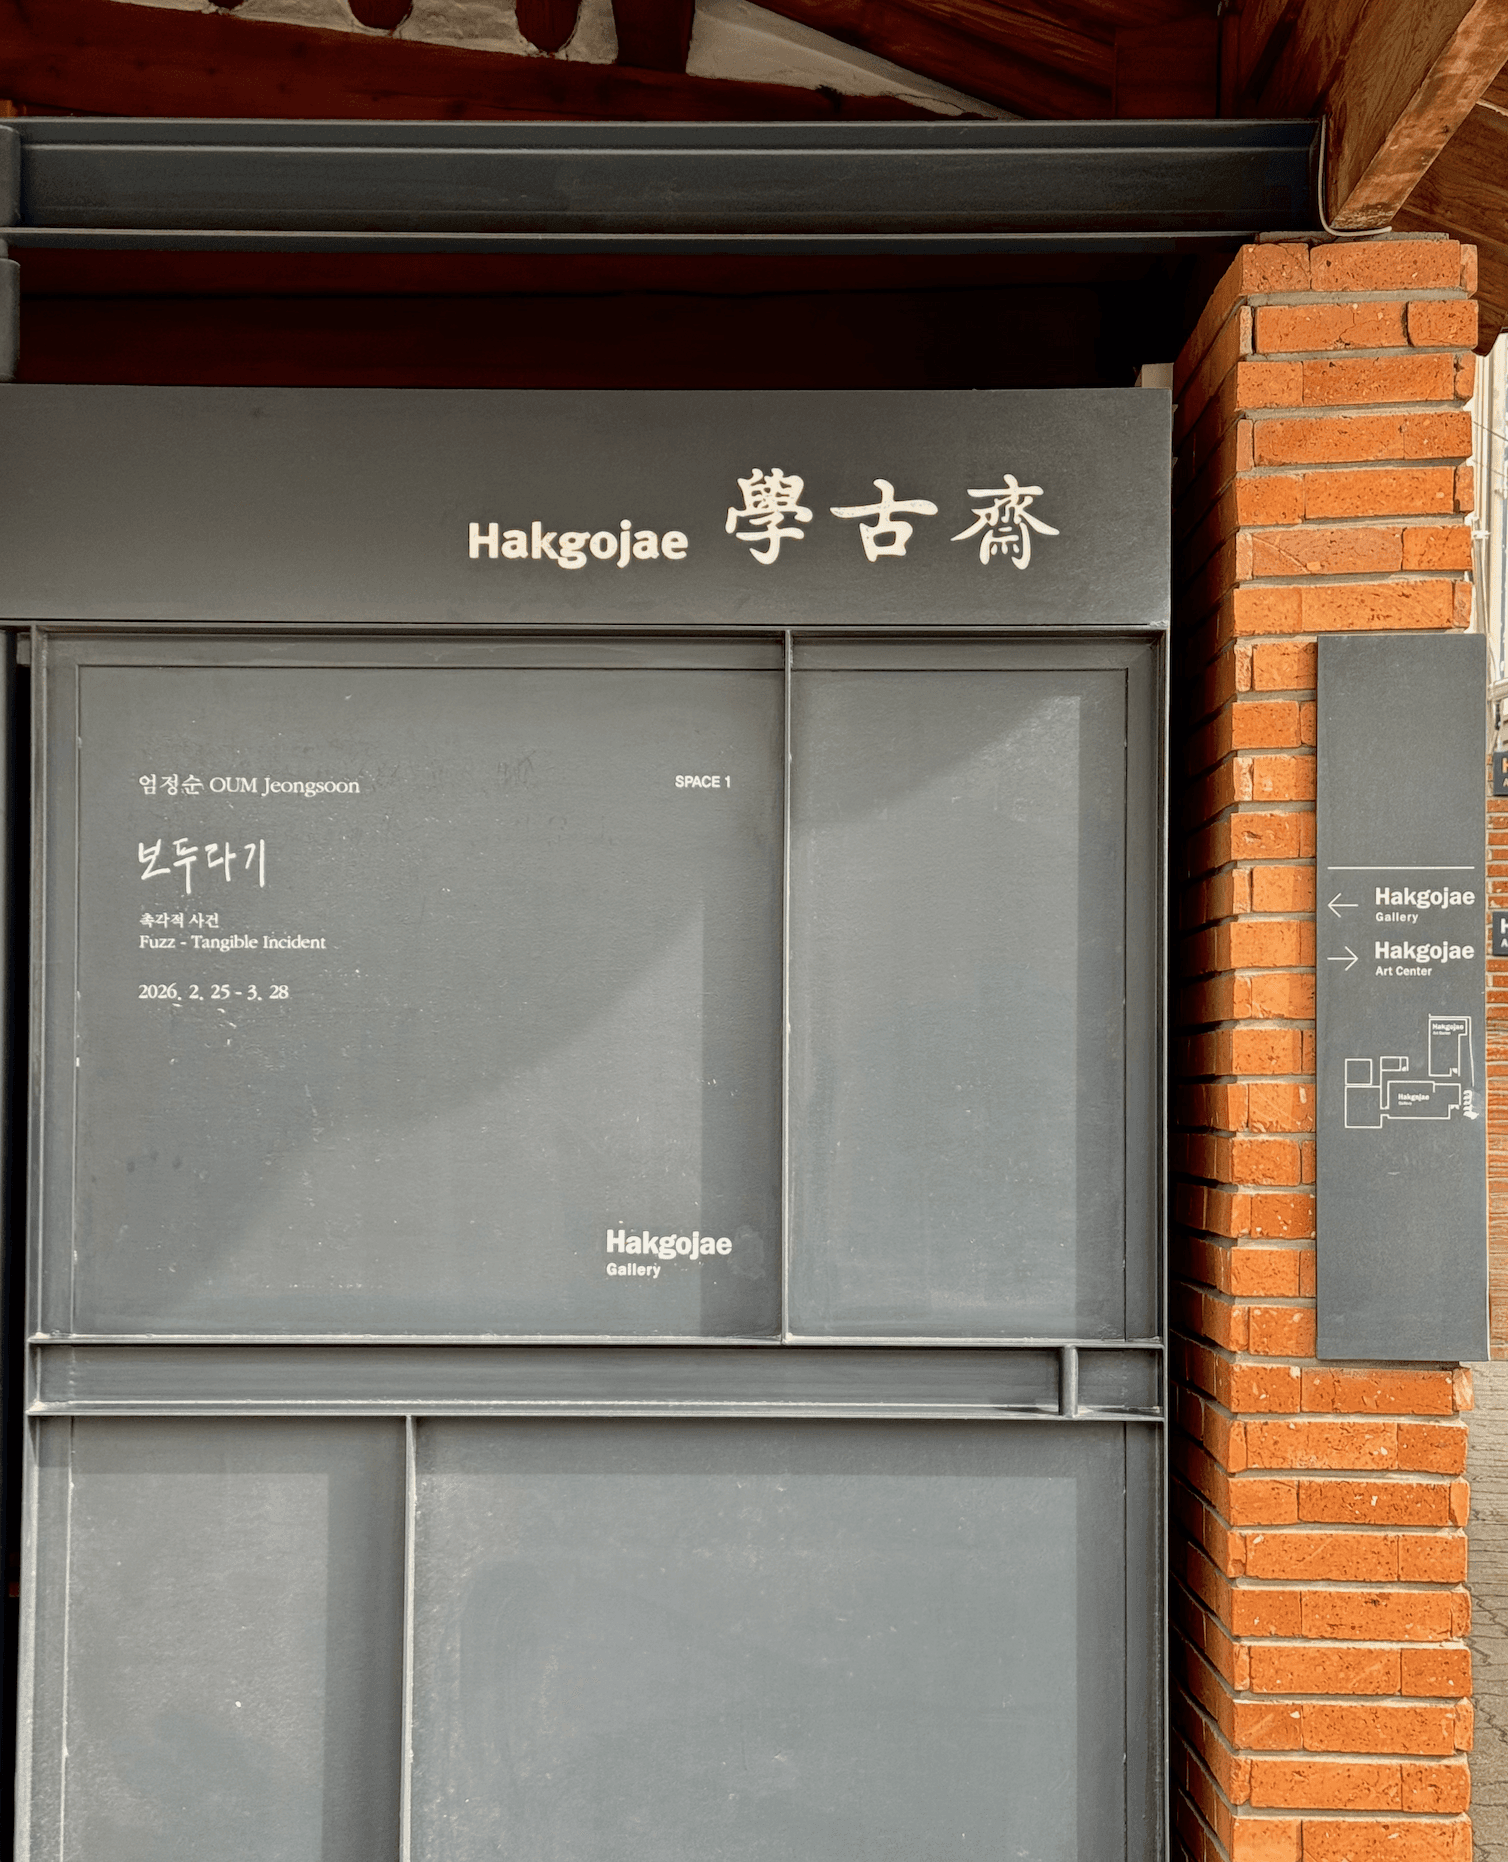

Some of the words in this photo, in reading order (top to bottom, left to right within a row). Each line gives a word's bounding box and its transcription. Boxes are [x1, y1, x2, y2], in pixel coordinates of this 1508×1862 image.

[468, 519, 689, 570] Hakgojae
[725, 467, 1060, 570] 學古齋
[138, 773, 203, 795] 엄정순
[209, 776, 258, 793] OUM
[261, 776, 361, 798] Jeongsoon
[674, 774, 721, 788] SPACE
[724, 775, 731, 788] 1
[1375, 886, 1476, 910] Hakgojae
[139, 912, 185, 929] 촉각적
[188, 912, 220, 929] 사건
[1375, 911, 1420, 924] Gallery
[139, 935, 176, 949] Fuzz
[190, 934, 259, 952] Tangible
[263, 934, 327, 949] Incident
[1374, 940, 1475, 964] Hakgojae
[1375, 966, 1394, 977] Art
[1395, 966, 1433, 977] Center
[138, 982, 182, 1001] 2026.
[188, 984, 204, 1001] 2.
[210, 984, 231, 1000] 25
[247, 984, 263, 1001] 3.
[268, 984, 289, 1000] 28
[606, 1229, 733, 1261] Hakgojae
[606, 1262, 661, 1279] Gallery
